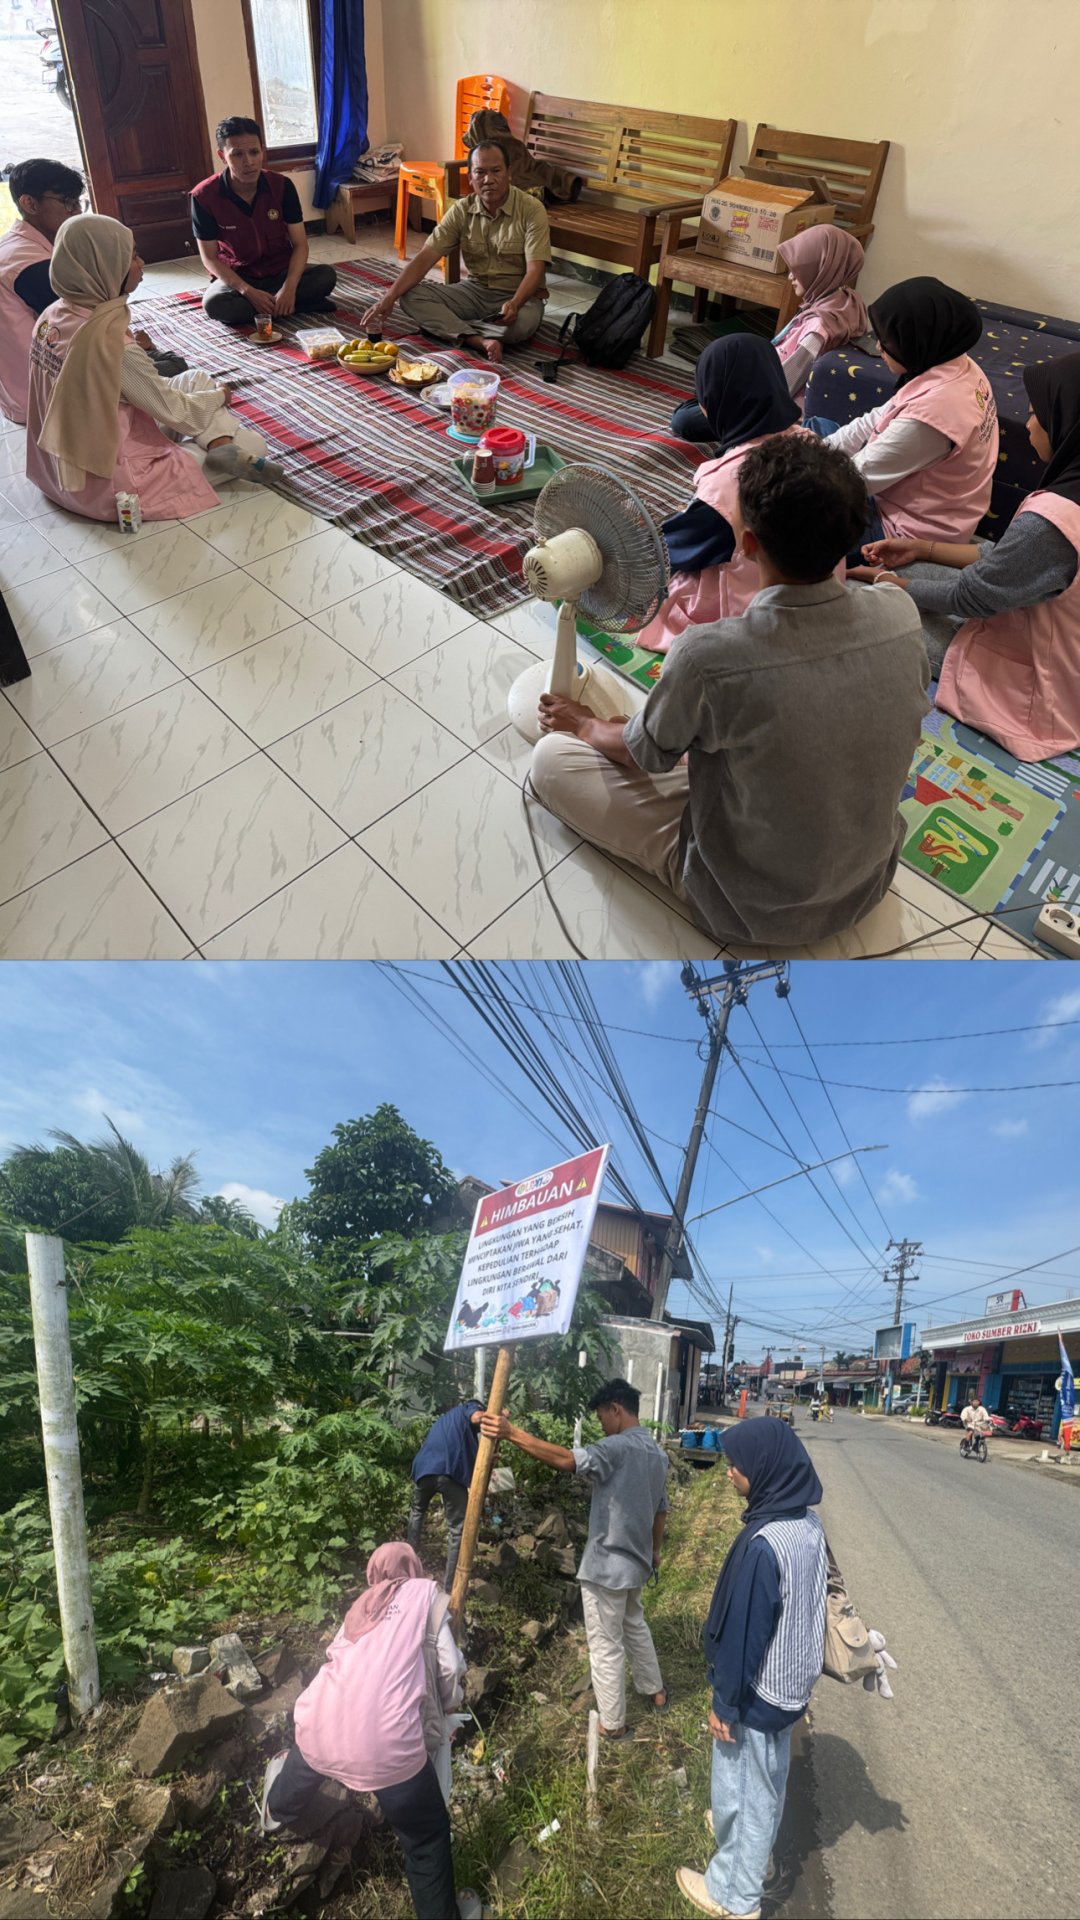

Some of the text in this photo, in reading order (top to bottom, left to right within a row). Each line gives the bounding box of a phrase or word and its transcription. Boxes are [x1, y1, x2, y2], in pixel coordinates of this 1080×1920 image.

[490, 1179, 574, 1225] HIMBAUAN
[478, 1208, 575, 1250] LINGKUNGAN YANG BERSIH
[468, 1243, 512, 1264] MENCIPTAKAN
[532, 1230, 553, 1244] YANG
[478, 1239, 560, 1272] KEPEDULIAN TERHADAP
[467, 1250, 568, 1287] LINGKUNGAN BERAWAL DARI
[482, 1284, 495, 1296] DIRI
[497, 1282, 512, 1292] KITA
[963, 1321, 1038, 1342] TOKO SUMBER RIZKI
